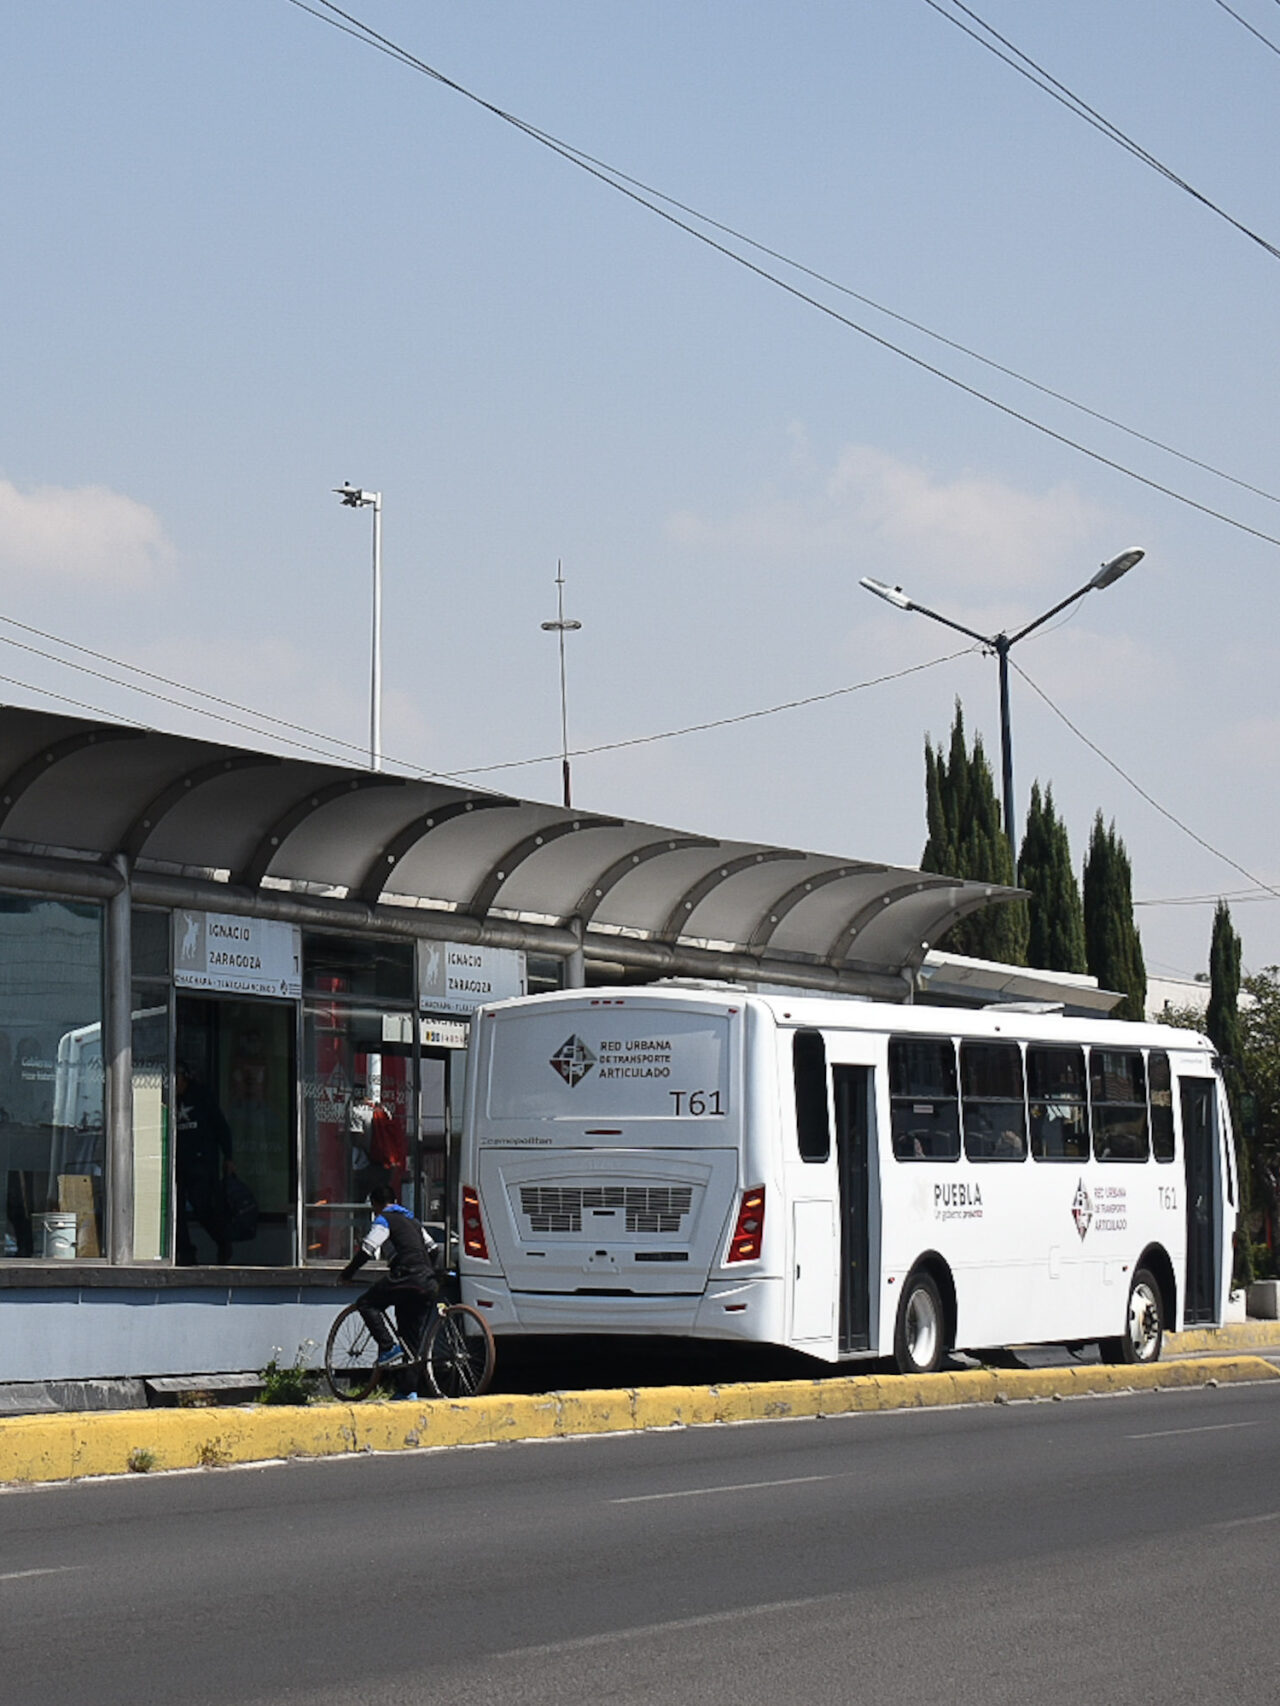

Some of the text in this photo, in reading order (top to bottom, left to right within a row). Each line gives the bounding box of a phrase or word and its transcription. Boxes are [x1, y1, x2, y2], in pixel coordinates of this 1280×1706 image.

[209, 924, 250, 941] IGNACIO
[209, 951, 261, 969] ZARAGOZA
[448, 952, 482, 967] IGNACIO
[448, 977, 491, 993] ZARAGOZA
[600, 1040, 671, 1051] RED URBANA
[599, 1054, 671, 1063] DE TRANSPORTE
[599, 1067, 670, 1078] ARTICULADO
[669, 1090, 725, 1116] T61
[934, 1183, 982, 1206] PUEBLA
[1158, 1186, 1177, 1210] T61
